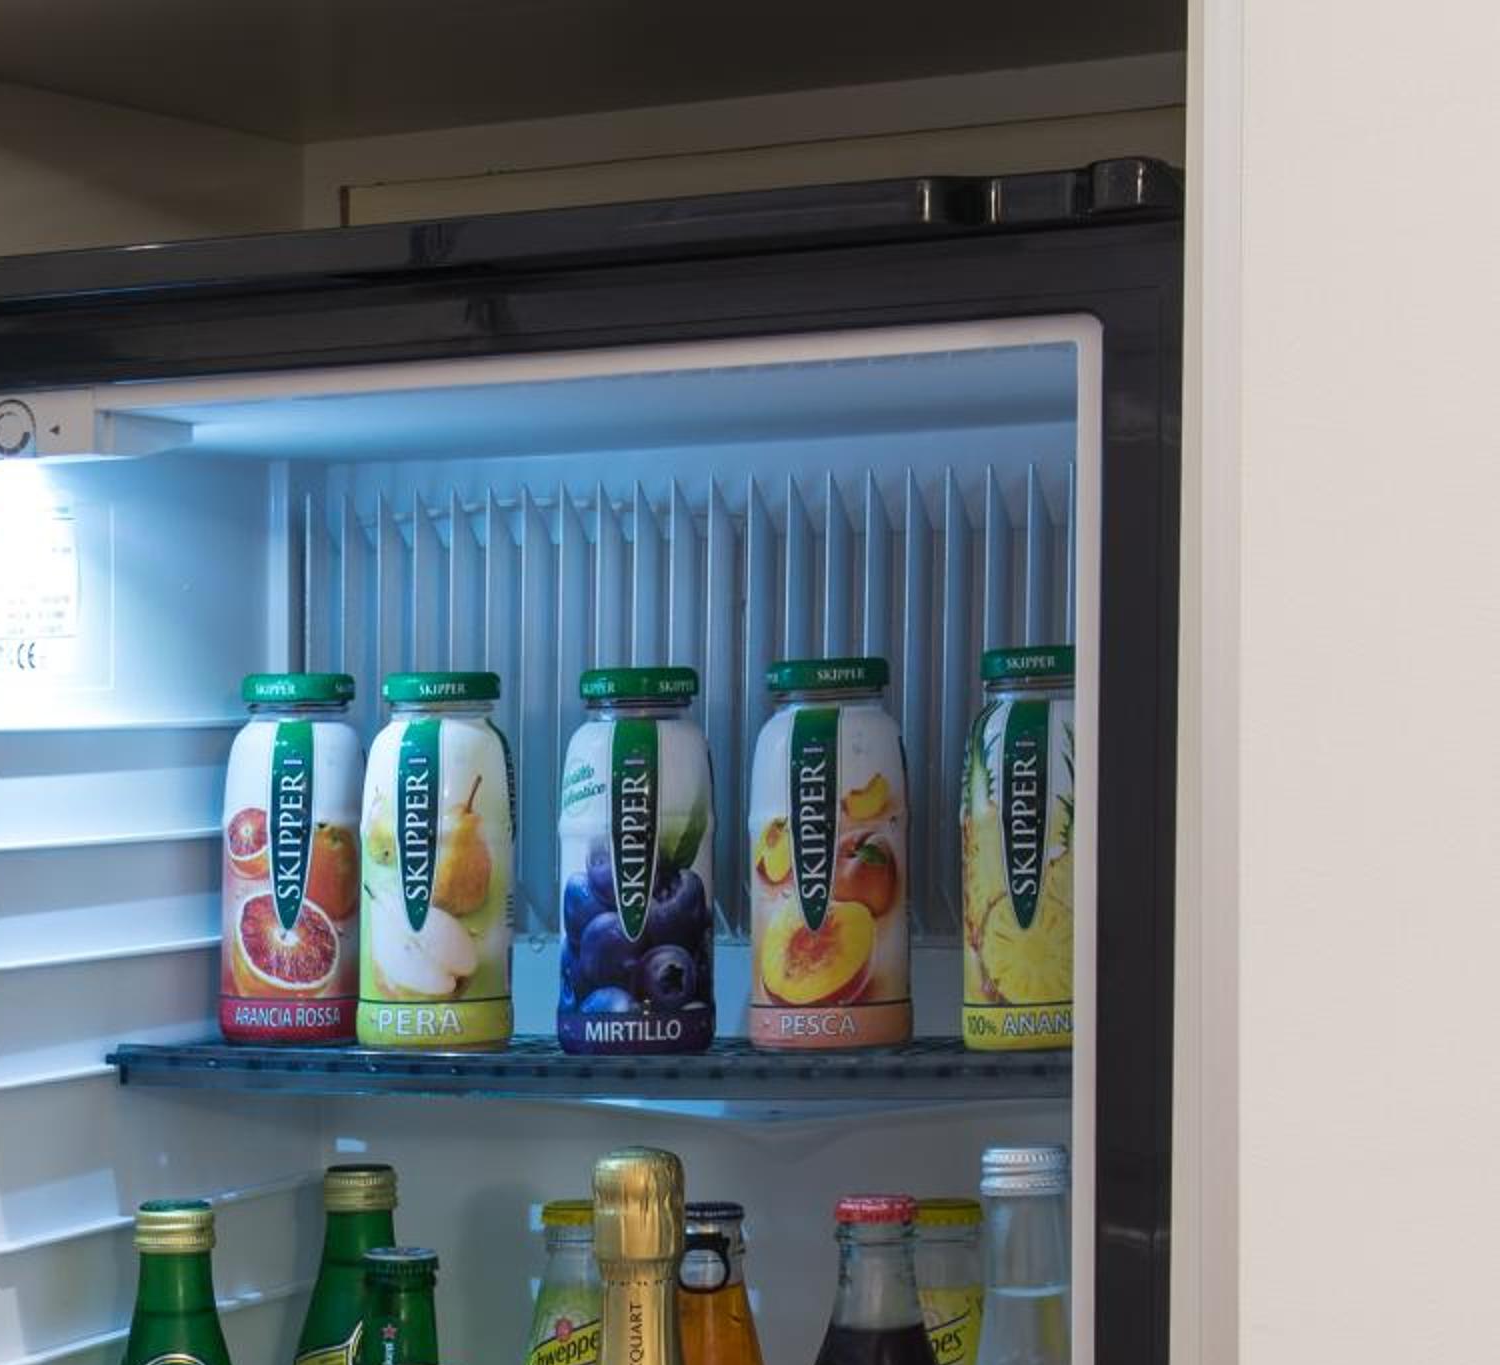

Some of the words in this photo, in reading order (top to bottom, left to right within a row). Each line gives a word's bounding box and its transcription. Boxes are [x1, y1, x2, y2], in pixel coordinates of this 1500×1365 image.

[419, 682, 467, 696] SKIPPER
[277, 771, 304, 900] SKIPPER
[405, 769, 430, 901] SKIPPER
[800, 758, 828, 900] SKIPPER
[1011, 753, 1038, 897] SKIPPER
[621, 771, 648, 908] SKIPPER
[235, 1008, 292, 1028] ARANCIA
[295, 1008, 341, 1026] ROSSA
[378, 1009, 462, 1036] PERA
[585, 1019, 682, 1042] MIRTILLO
[780, 1014, 855, 1036] PESCA
[1004, 1010, 1073, 1036] ANAN
